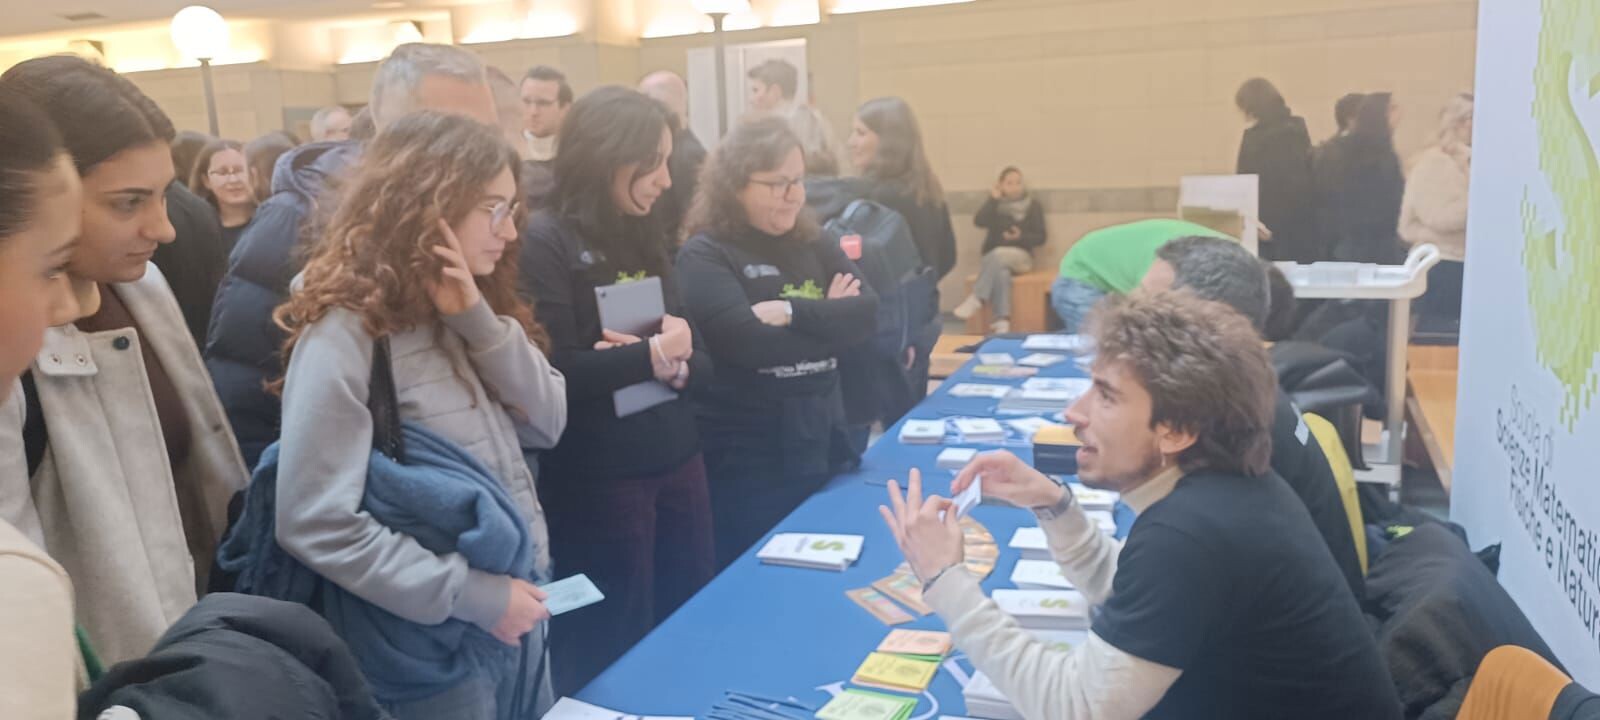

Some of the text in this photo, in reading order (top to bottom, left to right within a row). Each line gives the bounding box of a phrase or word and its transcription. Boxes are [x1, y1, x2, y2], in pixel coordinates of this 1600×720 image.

[1497, 408, 1531, 486] Scienze
[1511, 384, 1555, 472] Scuola di
[1510, 466, 1600, 653] Fisiche e Natur
